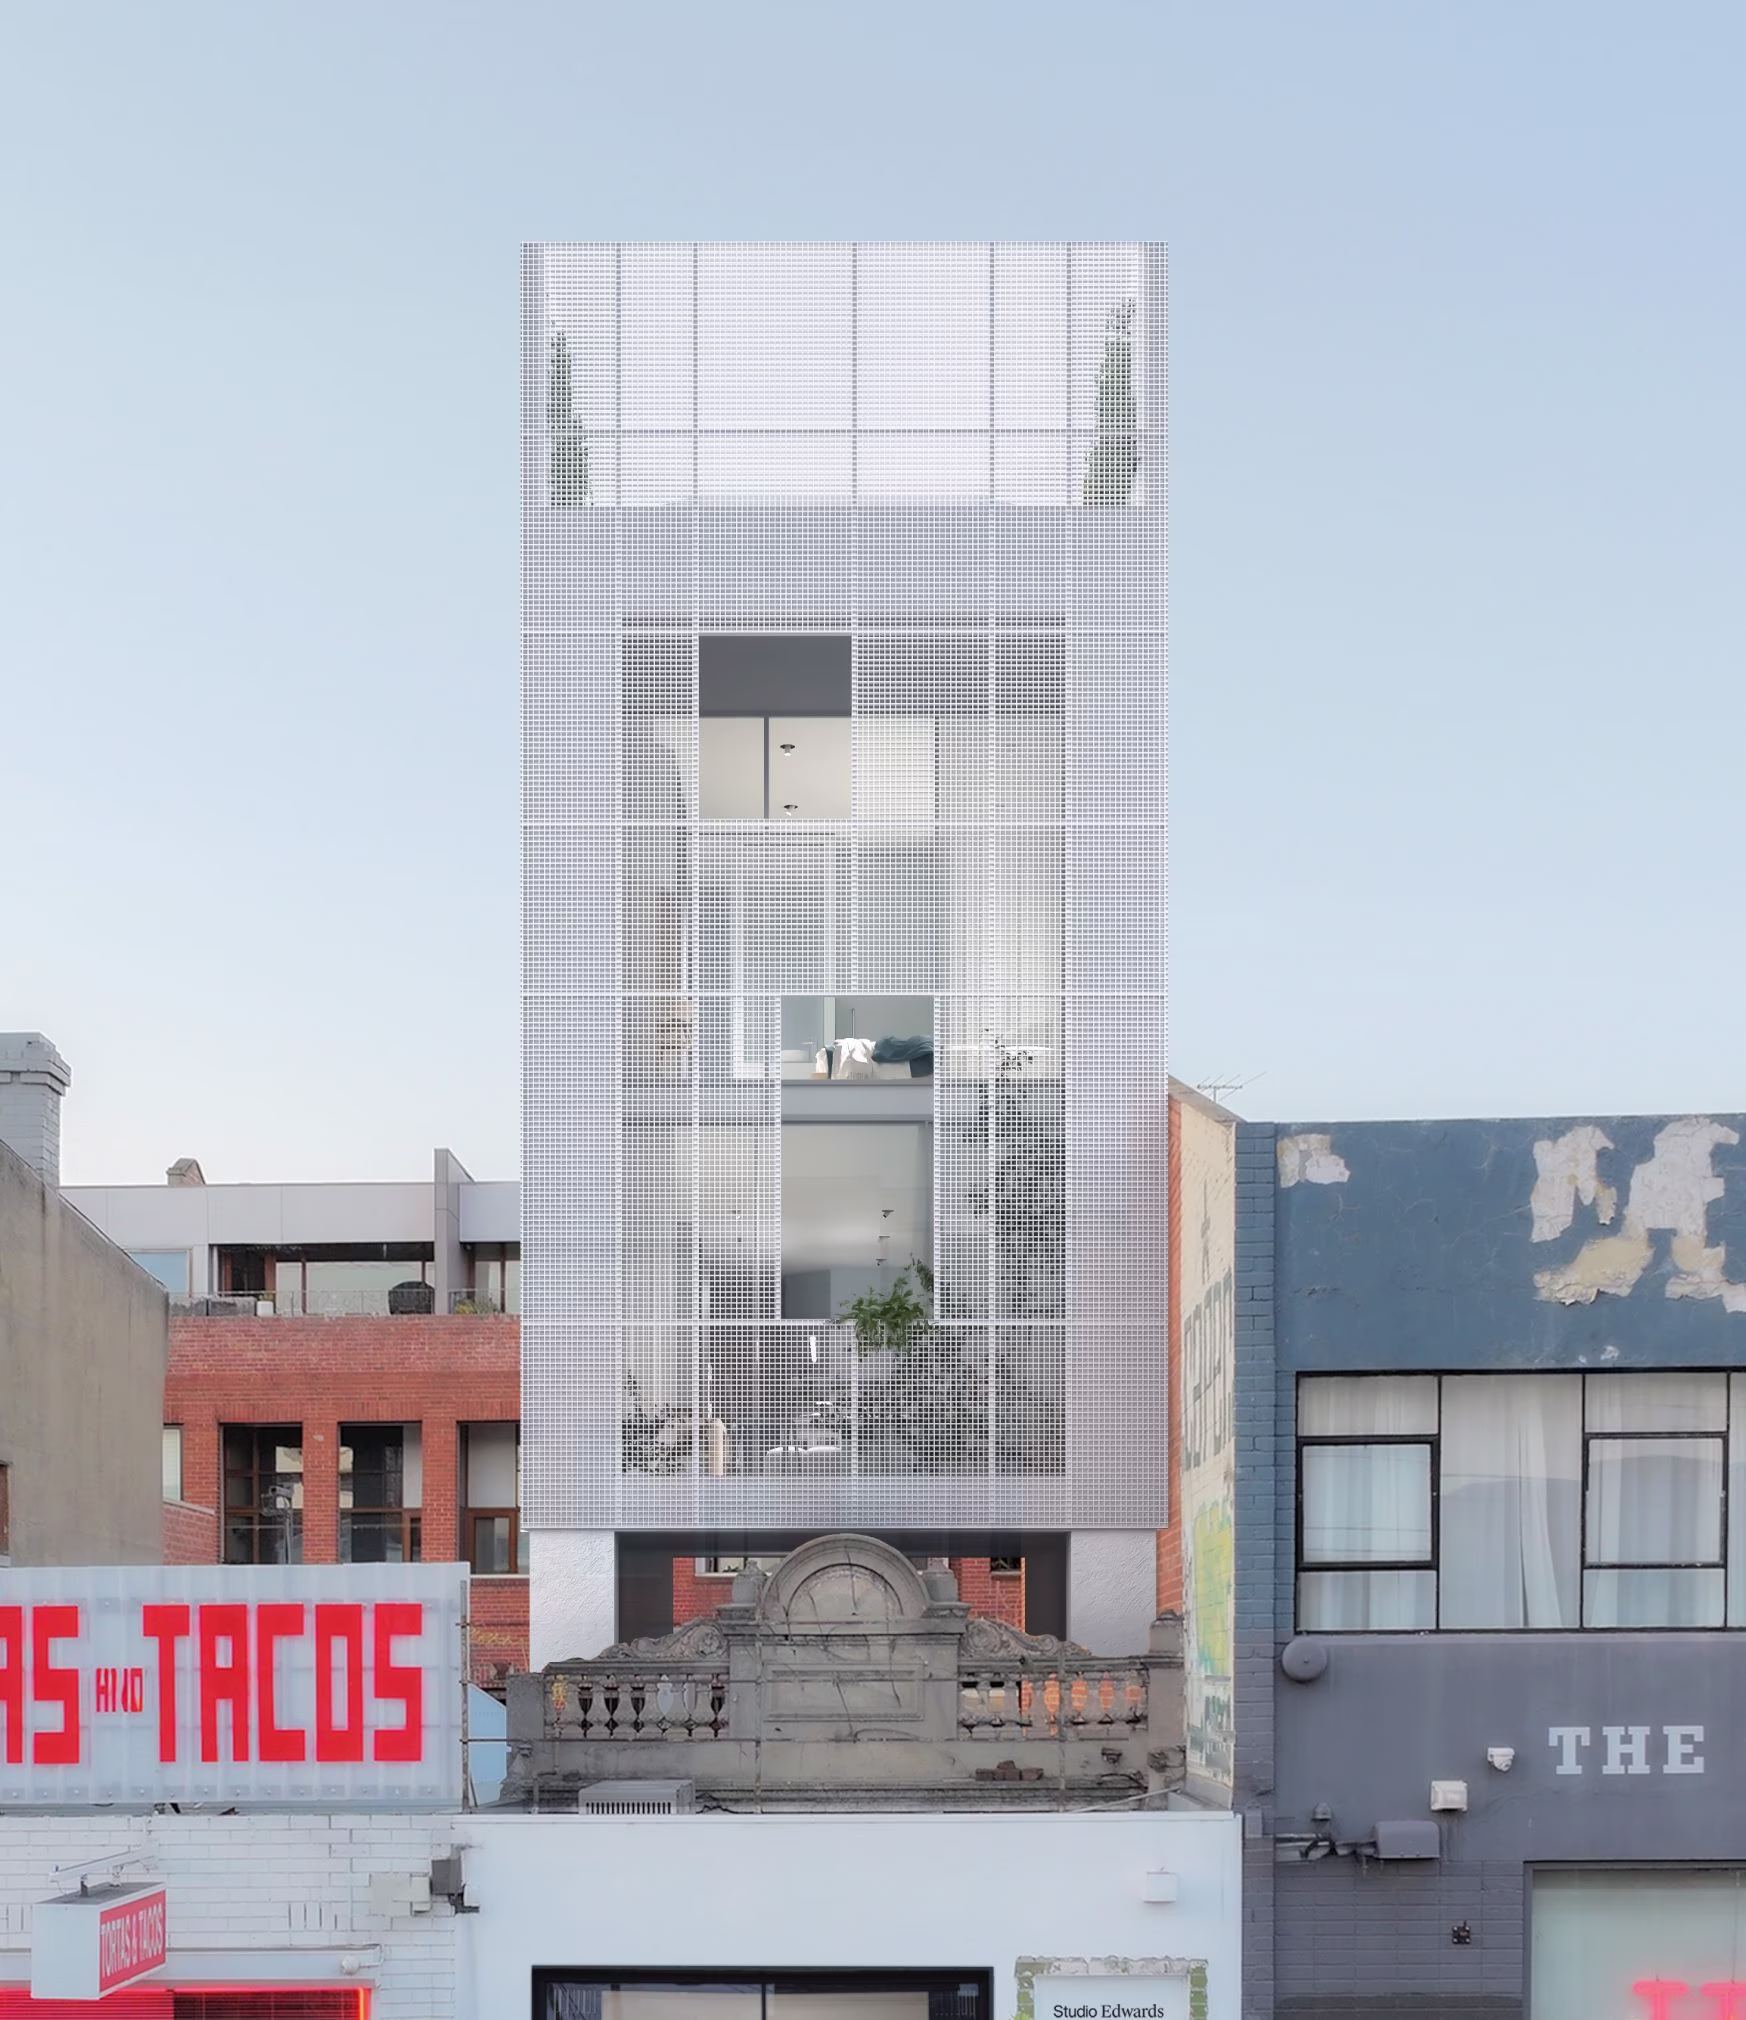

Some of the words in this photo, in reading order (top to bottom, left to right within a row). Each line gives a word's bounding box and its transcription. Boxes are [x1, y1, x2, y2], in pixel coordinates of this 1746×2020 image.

[143, 1603, 422, 1763] TACOS
[1549, 1725, 1704, 1775] THE
[100, 1914, 130, 1978] TORTAS
[139, 1902, 163, 1961] TACOS
[1053, 2004, 1097, 2018] Studio
[1101, 2003, 1164, 2019] Edwards
